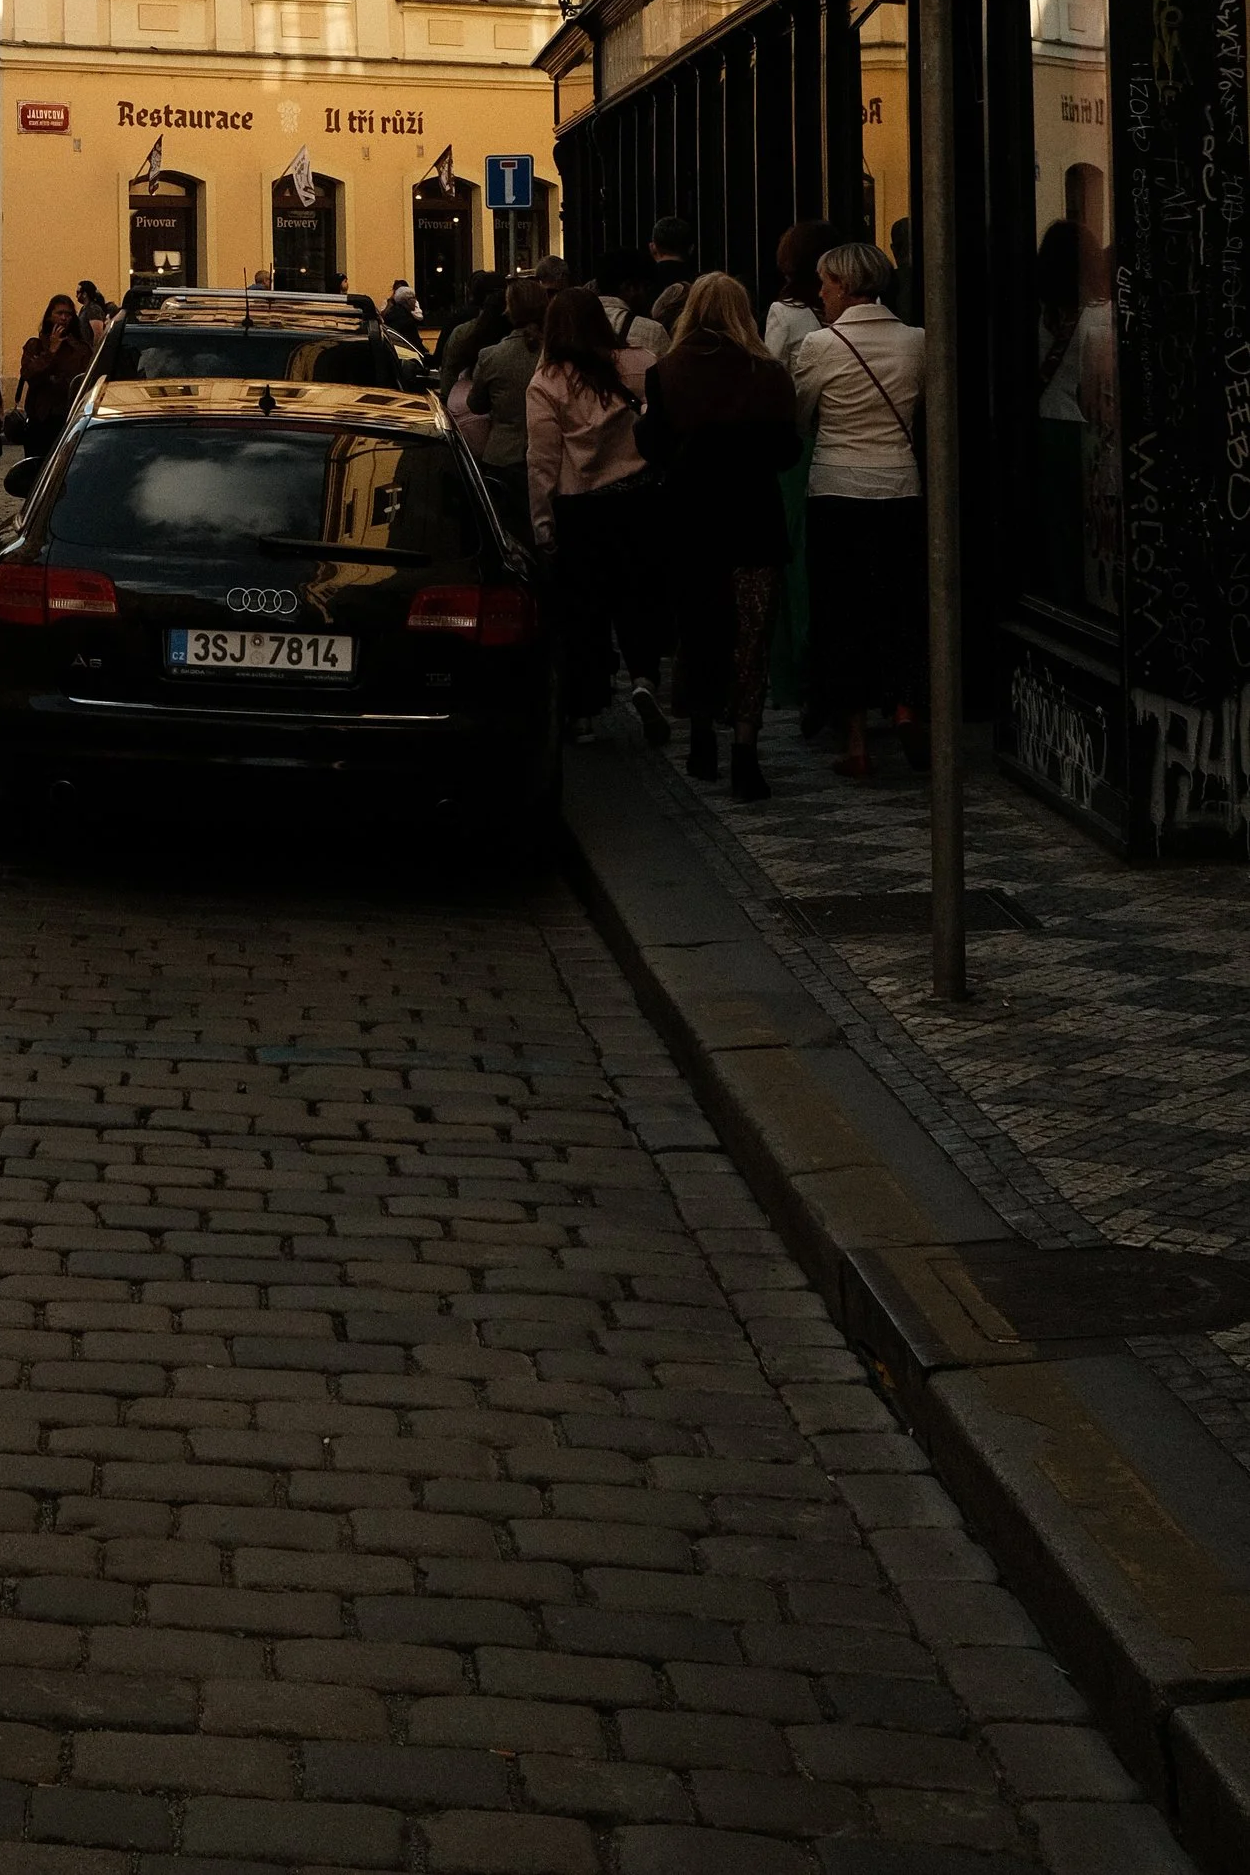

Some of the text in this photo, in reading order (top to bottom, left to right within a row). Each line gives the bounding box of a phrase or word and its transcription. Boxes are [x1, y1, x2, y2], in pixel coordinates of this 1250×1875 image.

[117, 101, 254, 131] Restaurace
[347, 109, 374, 135] tří
[380, 109, 424, 135] růží
[135, 215, 177, 228] Pivovar
[276, 216, 318, 230] Brewery
[494, 218, 532, 231] Breery
[172, 651, 185, 661] CZ
[194, 633, 338, 667] 3SJ 7814
